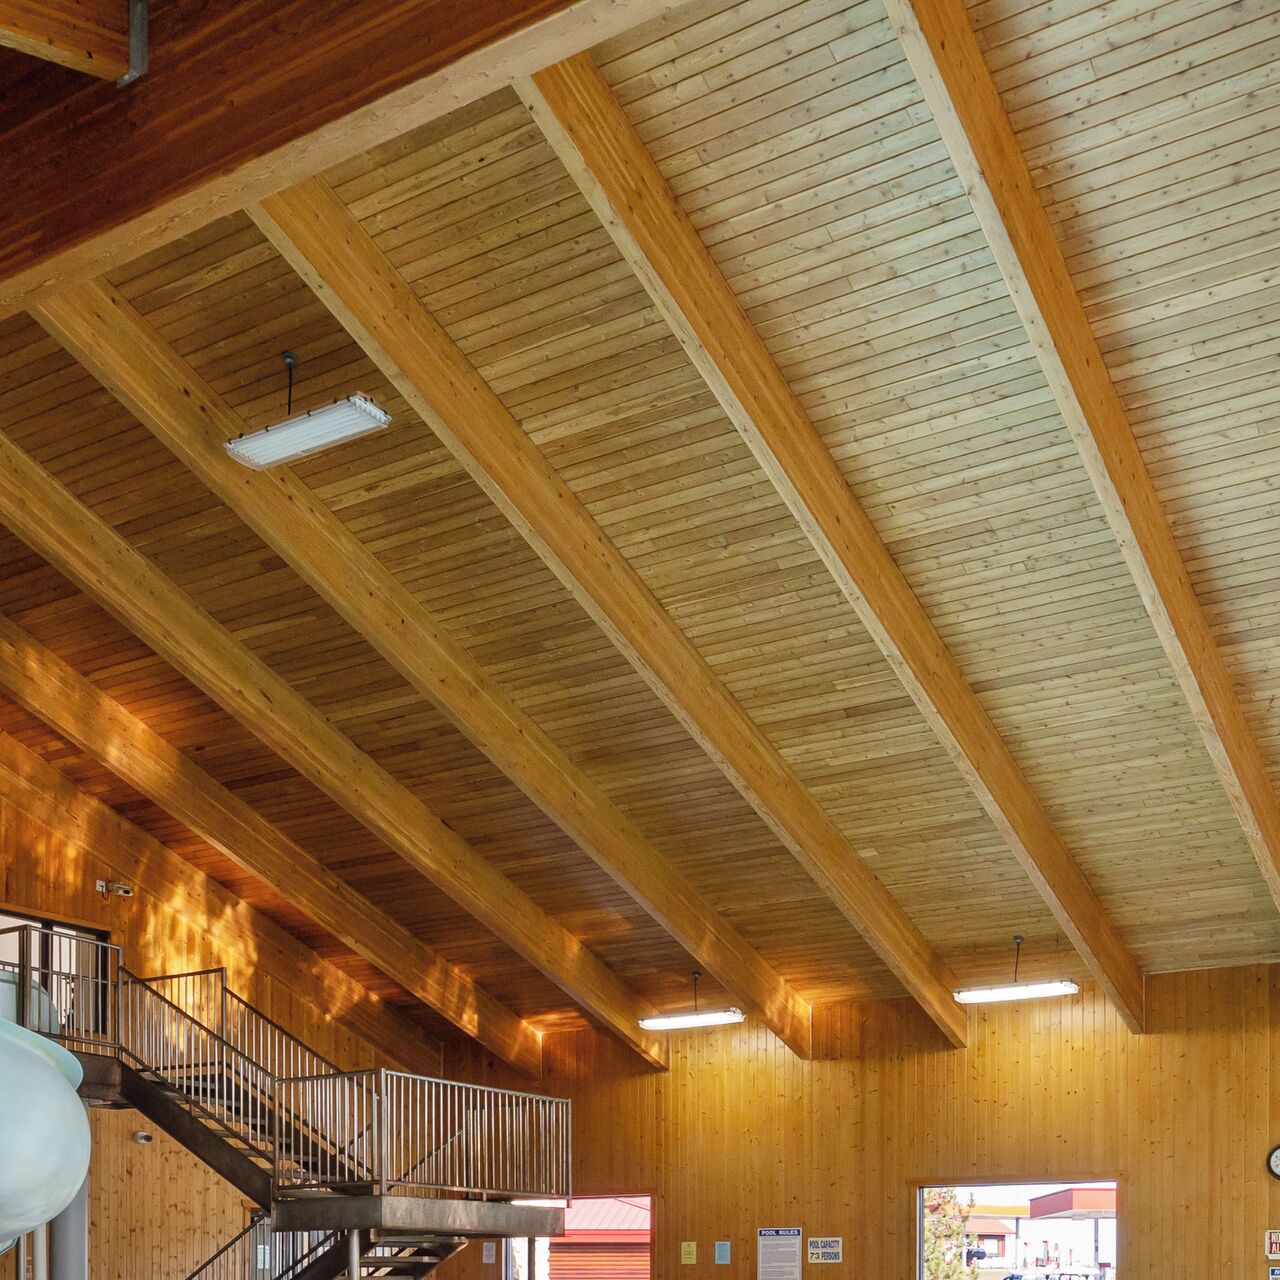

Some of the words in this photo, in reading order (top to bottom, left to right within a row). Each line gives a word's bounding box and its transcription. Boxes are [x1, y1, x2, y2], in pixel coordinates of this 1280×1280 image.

[1271, 1232, 1280, 1243] NO
[809, 1240, 820, 1249] POOL
[809, 1252, 820, 1260] 73
[821, 1252, 840, 1260] PERSONS
